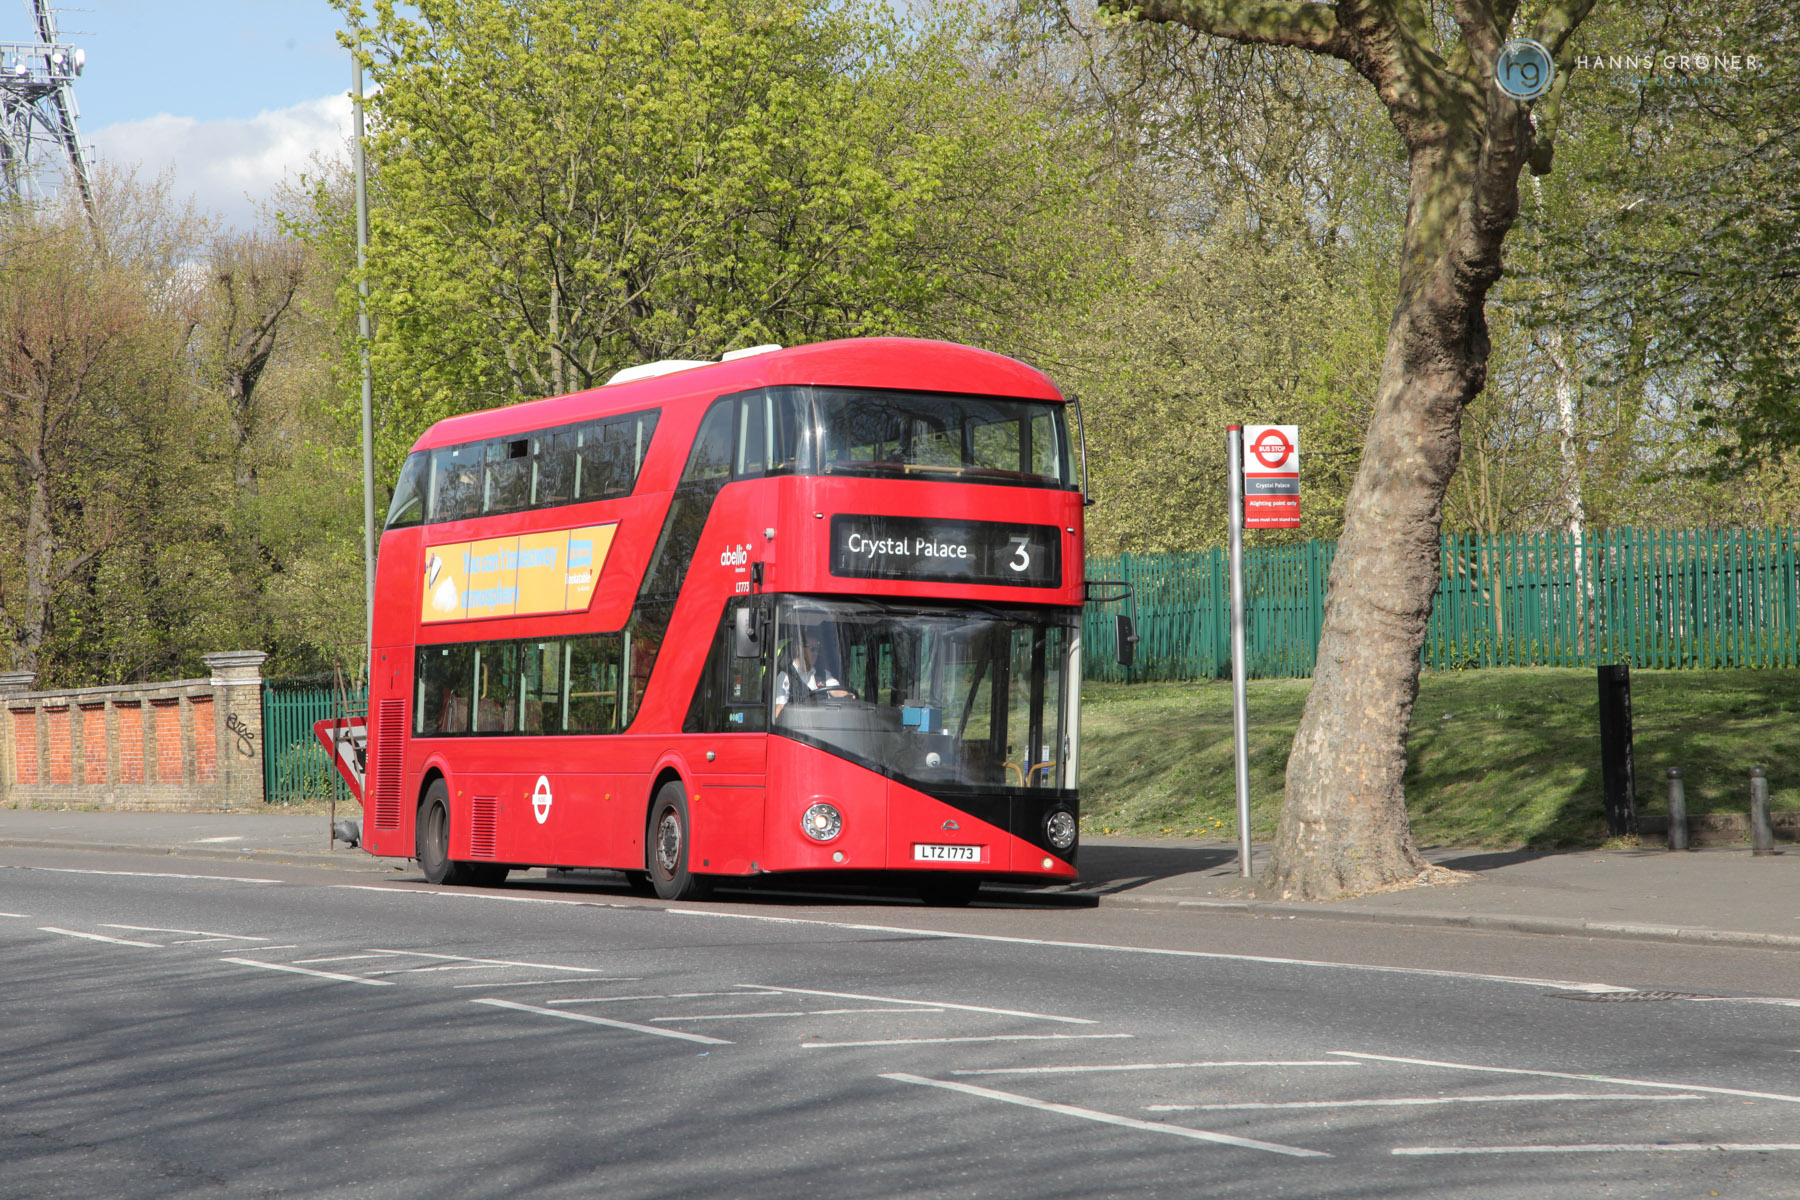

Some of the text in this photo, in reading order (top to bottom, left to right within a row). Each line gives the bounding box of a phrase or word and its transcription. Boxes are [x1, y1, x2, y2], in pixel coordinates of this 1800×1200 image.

[721, 544, 748, 566] abellio
[848, 533, 967, 559] Crystal Palace
[1009, 537, 1030, 572] 3
